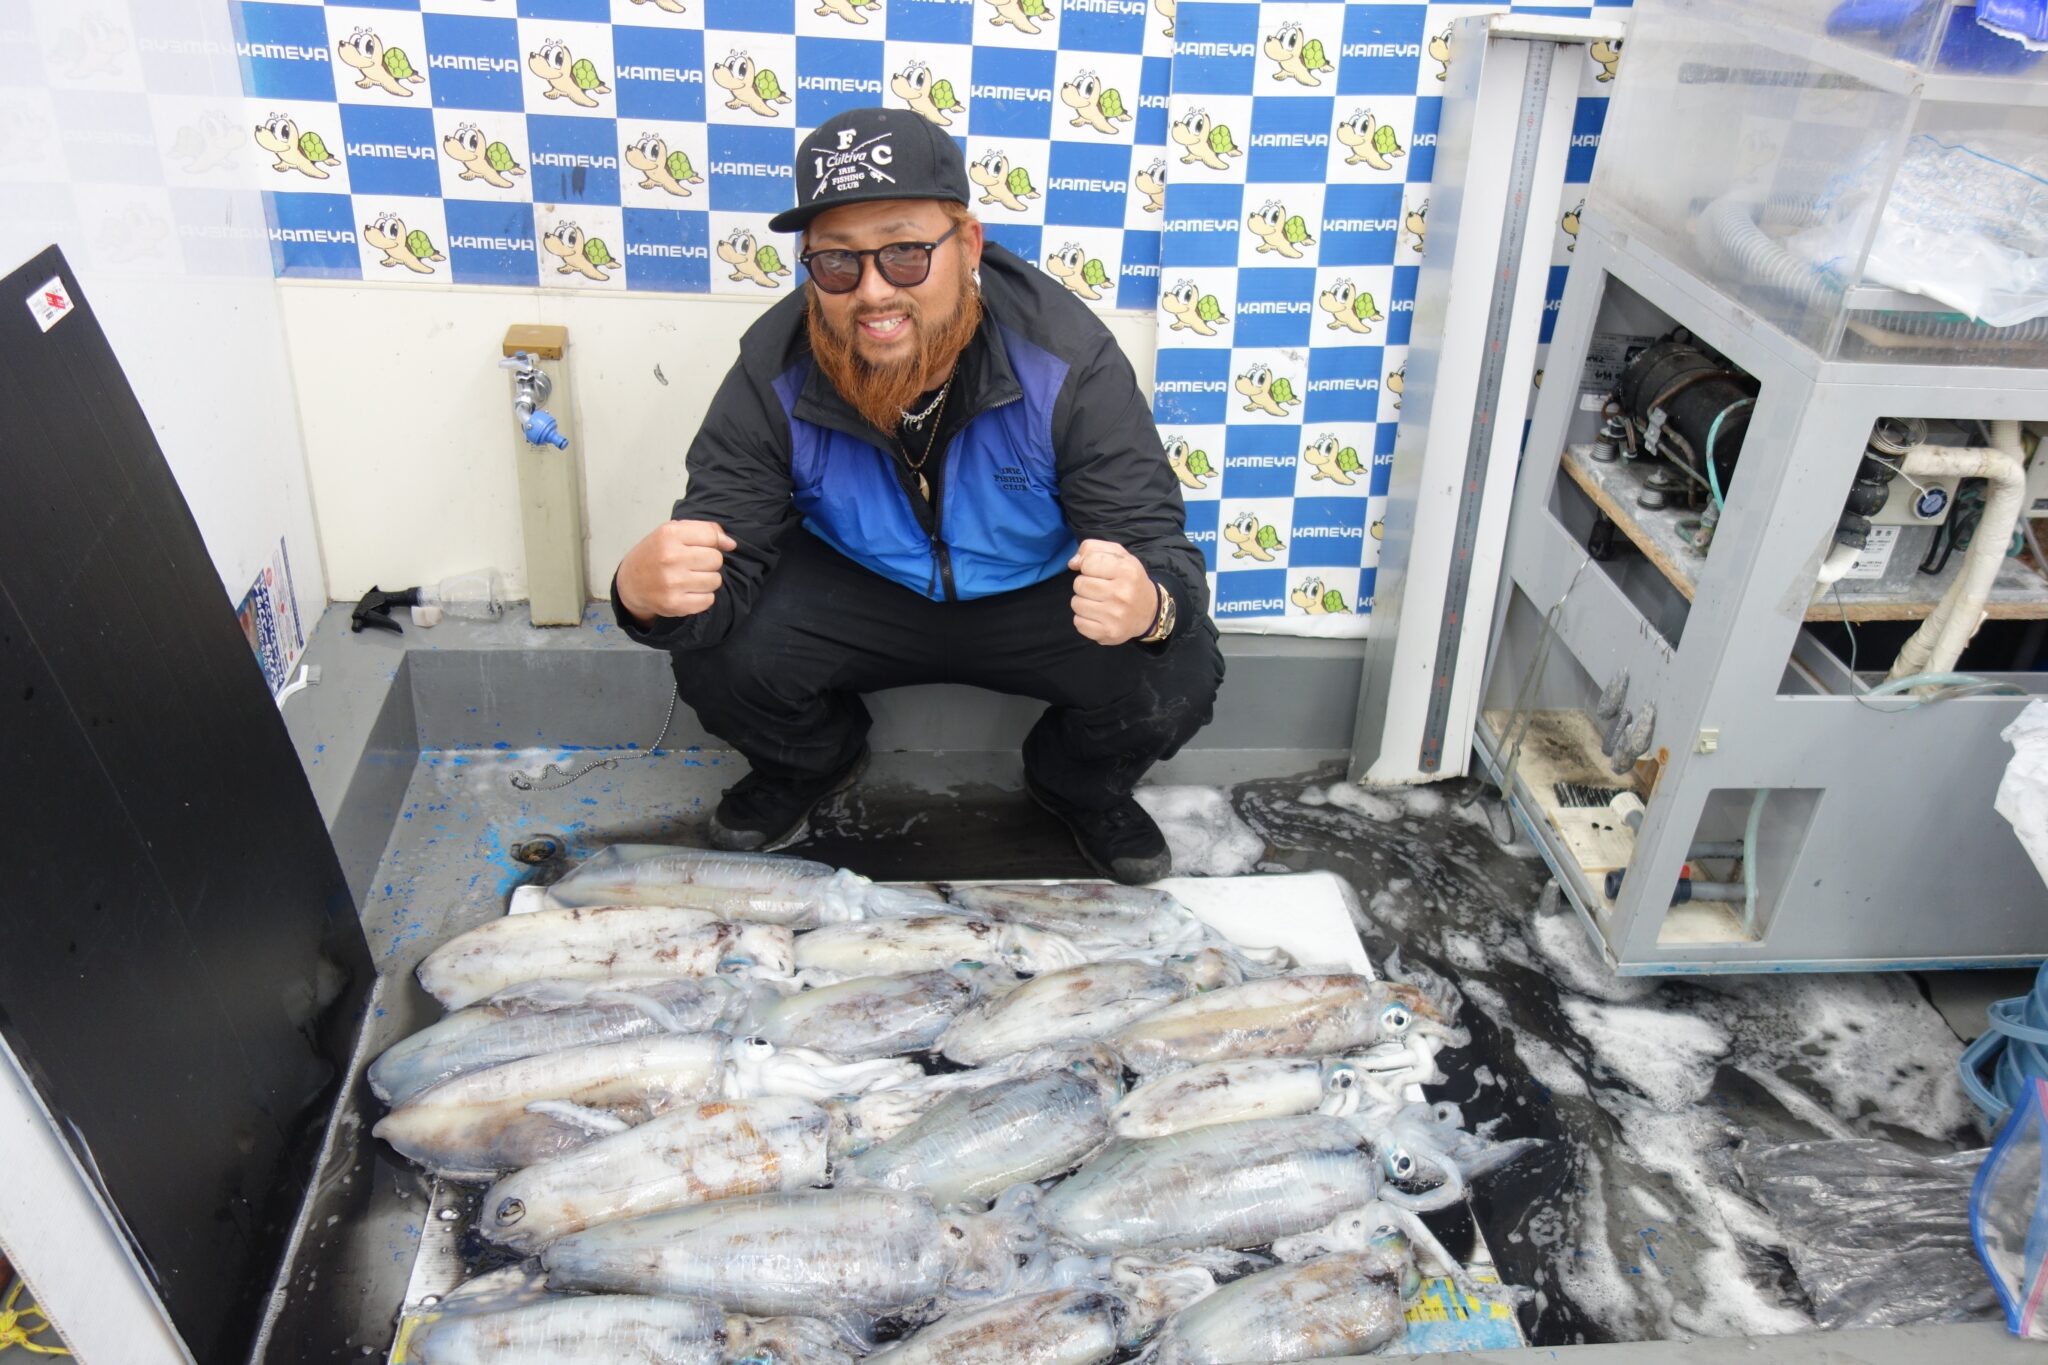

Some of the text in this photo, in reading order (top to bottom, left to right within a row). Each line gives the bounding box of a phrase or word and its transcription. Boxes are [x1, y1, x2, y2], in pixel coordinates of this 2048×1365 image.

[1063, 0, 1145, 15] KAMEYA
[236, 42, 329, 62] KAMEYA
[1174, 42, 1254, 57] KAMEYA
[1342, 43, 1420, 57] KAMEYA
[429, 56, 519, 73] KAMEYA
[616, 66, 703, 84] KAMEYA
[797, 76, 882, 93] KAMEYA
[970, 85, 1052, 101] KAMEYA
[837, 129, 857, 150] F
[1251, 134, 1328, 147] KAMEYA
[347, 143, 436, 161] KAMEYA
[871, 145, 893, 165] C
[532, 152, 617, 169] KAMEYA
[826, 152, 867, 168] Cultiva
[710, 161, 793, 178] KAMEYA
[838, 166, 856, 175] IRIE
[832, 172, 865, 185] FISHING
[837, 181, 859, 191] CLUB
[1049, 178, 1127, 193] KAMEYA
[1164, 219, 1239, 233] KAMEYA
[1323, 219, 1397, 231] KAMEYA
[269, 227, 355, 245] KAMEYA
[450, 236, 534, 252] KAMEYA
[626, 243, 708, 259] KAMEYA
[1122, 264, 1159, 277] KAM
[1237, 302, 1311, 315] KAMEYA
[1155, 381, 1227, 393] KAMEYA
[1308, 379, 1378, 391] KAMEYA
[1226, 455, 1296, 467] KAMEYA
[1186, 531, 1217, 542] EYA
[1292, 527, 1362, 539] KAMEYA
[1216, 598, 1284, 612] KAMEYA
